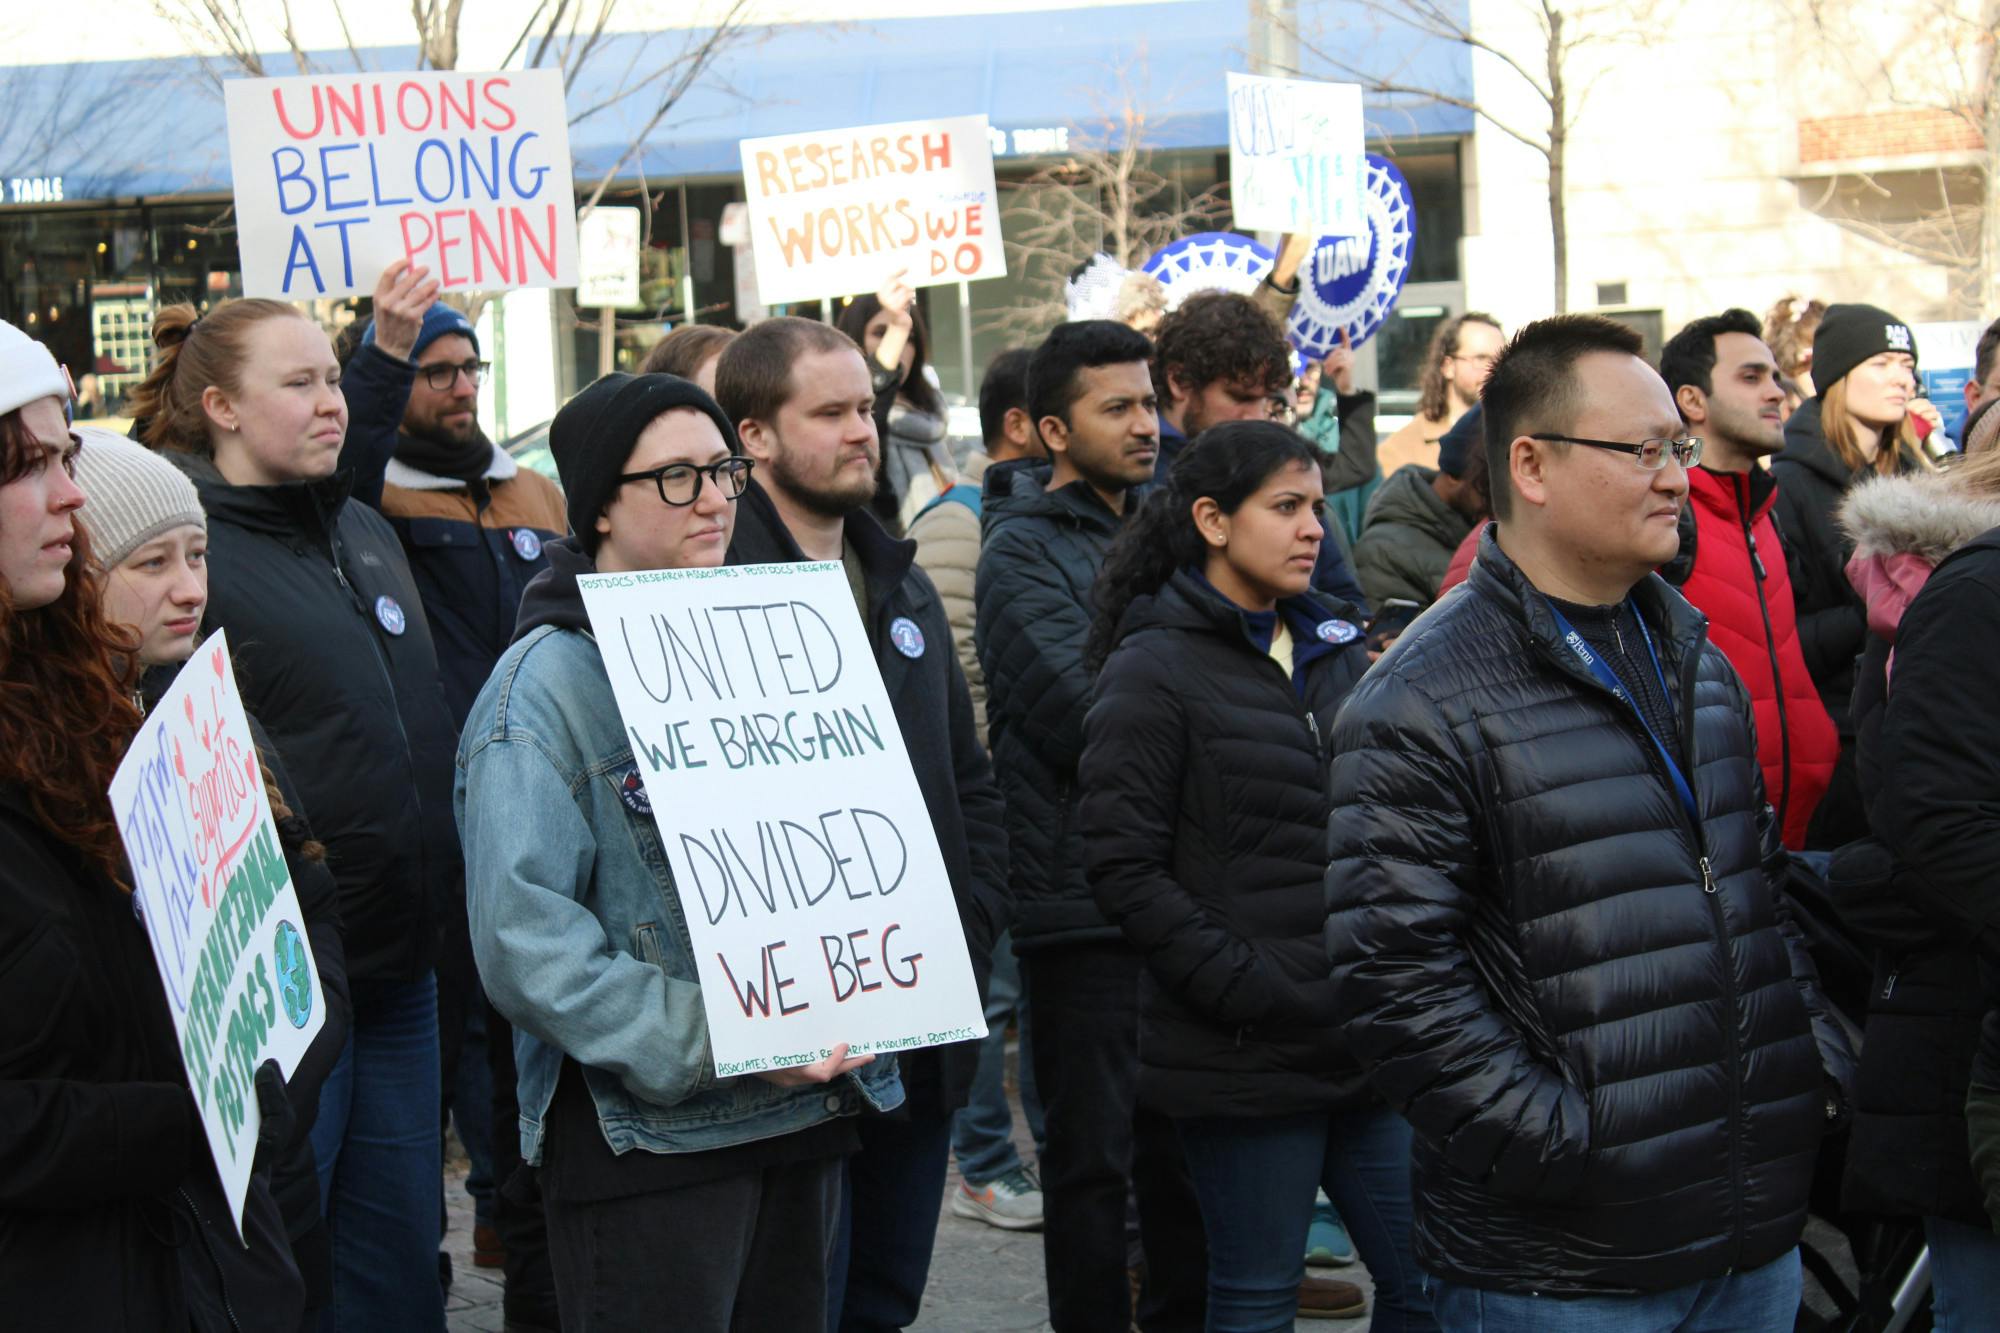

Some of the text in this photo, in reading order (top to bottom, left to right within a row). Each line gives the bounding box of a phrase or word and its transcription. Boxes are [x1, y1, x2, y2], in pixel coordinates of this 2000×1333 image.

[273, 78, 516, 140] UNIONS
[271, 131, 551, 215] BELONG
[756, 132, 952, 197] RESEARSH
[282, 204, 557, 293] AT PENN
[768, 198, 920, 268] WORKS
[925, 204, 983, 241] WE
[931, 242, 983, 276] DO
[1315, 230, 1373, 285] UAW
[620, 600, 842, 703] UNITED
[1573, 640, 1594, 666] Penn
[630, 704, 886, 772] WE BARGAIN
[680, 808, 907, 925] DIVIDED
[184, 818, 289, 1120] INTERNATIONAL
[717, 923, 923, 1018] WE BEG
[214, 953, 276, 1165] POSTDOCS
[820, 1043, 870, 1058] REARCH
